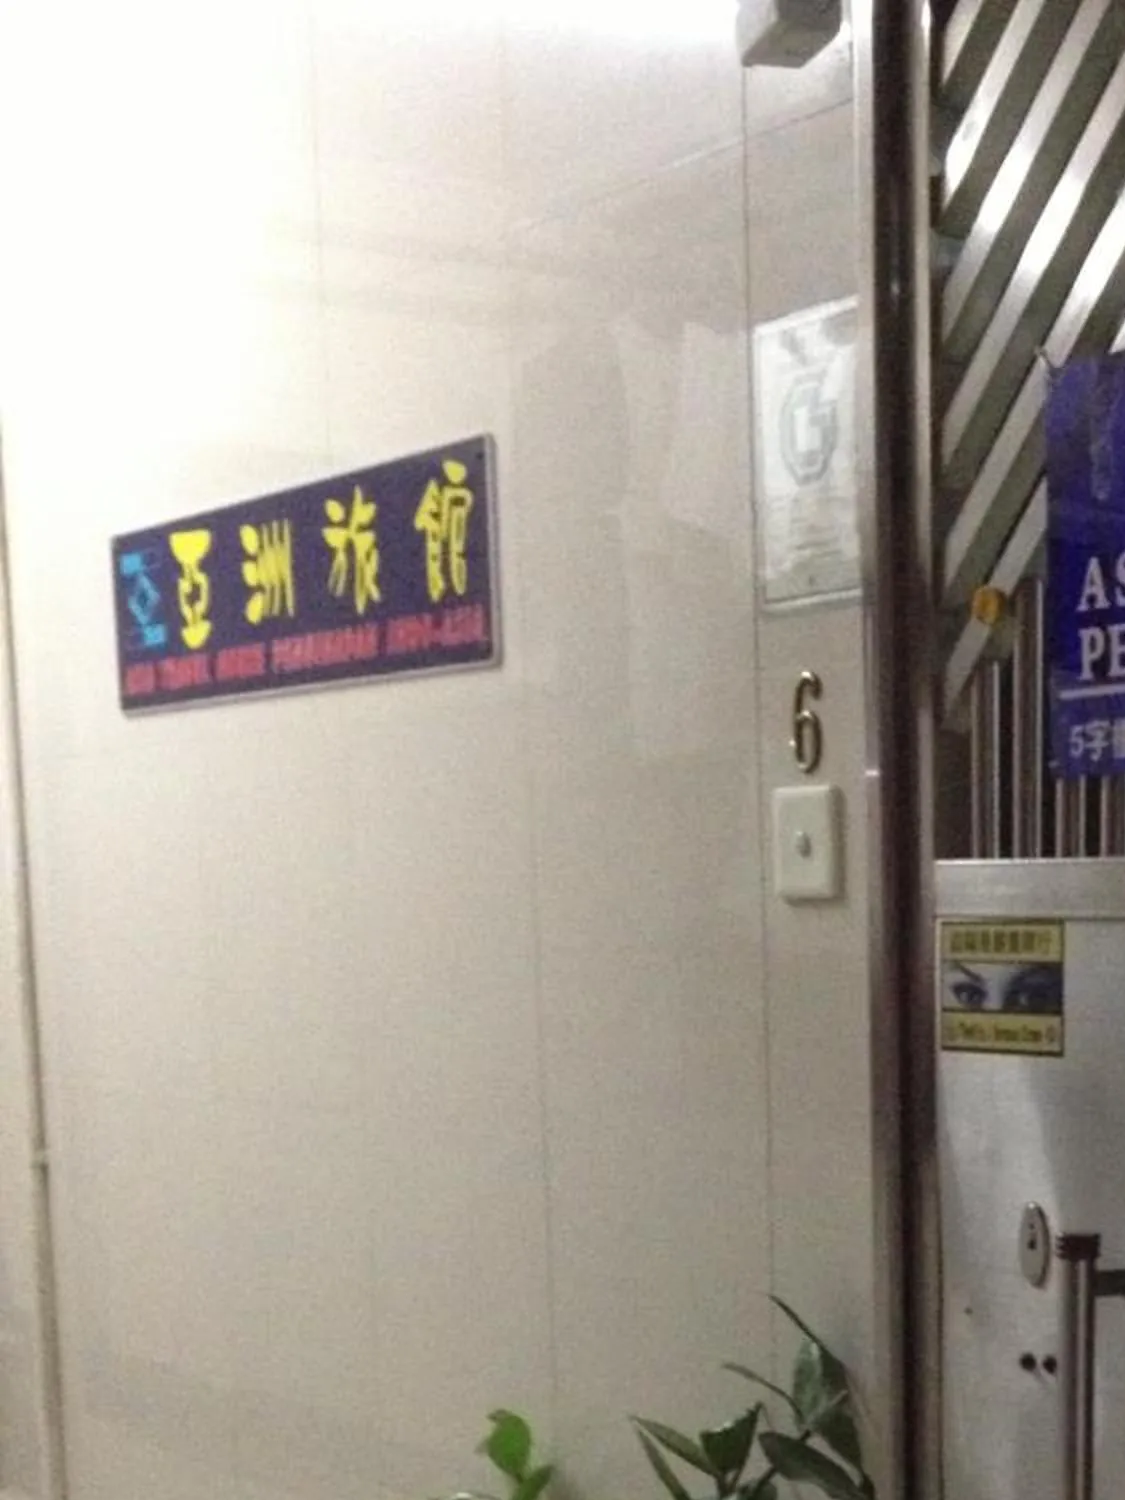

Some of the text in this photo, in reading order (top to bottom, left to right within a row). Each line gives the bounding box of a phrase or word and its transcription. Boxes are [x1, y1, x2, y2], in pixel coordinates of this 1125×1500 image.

[169, 458, 474, 649] 亞洲旅館
[793, 671, 824, 774] 6
